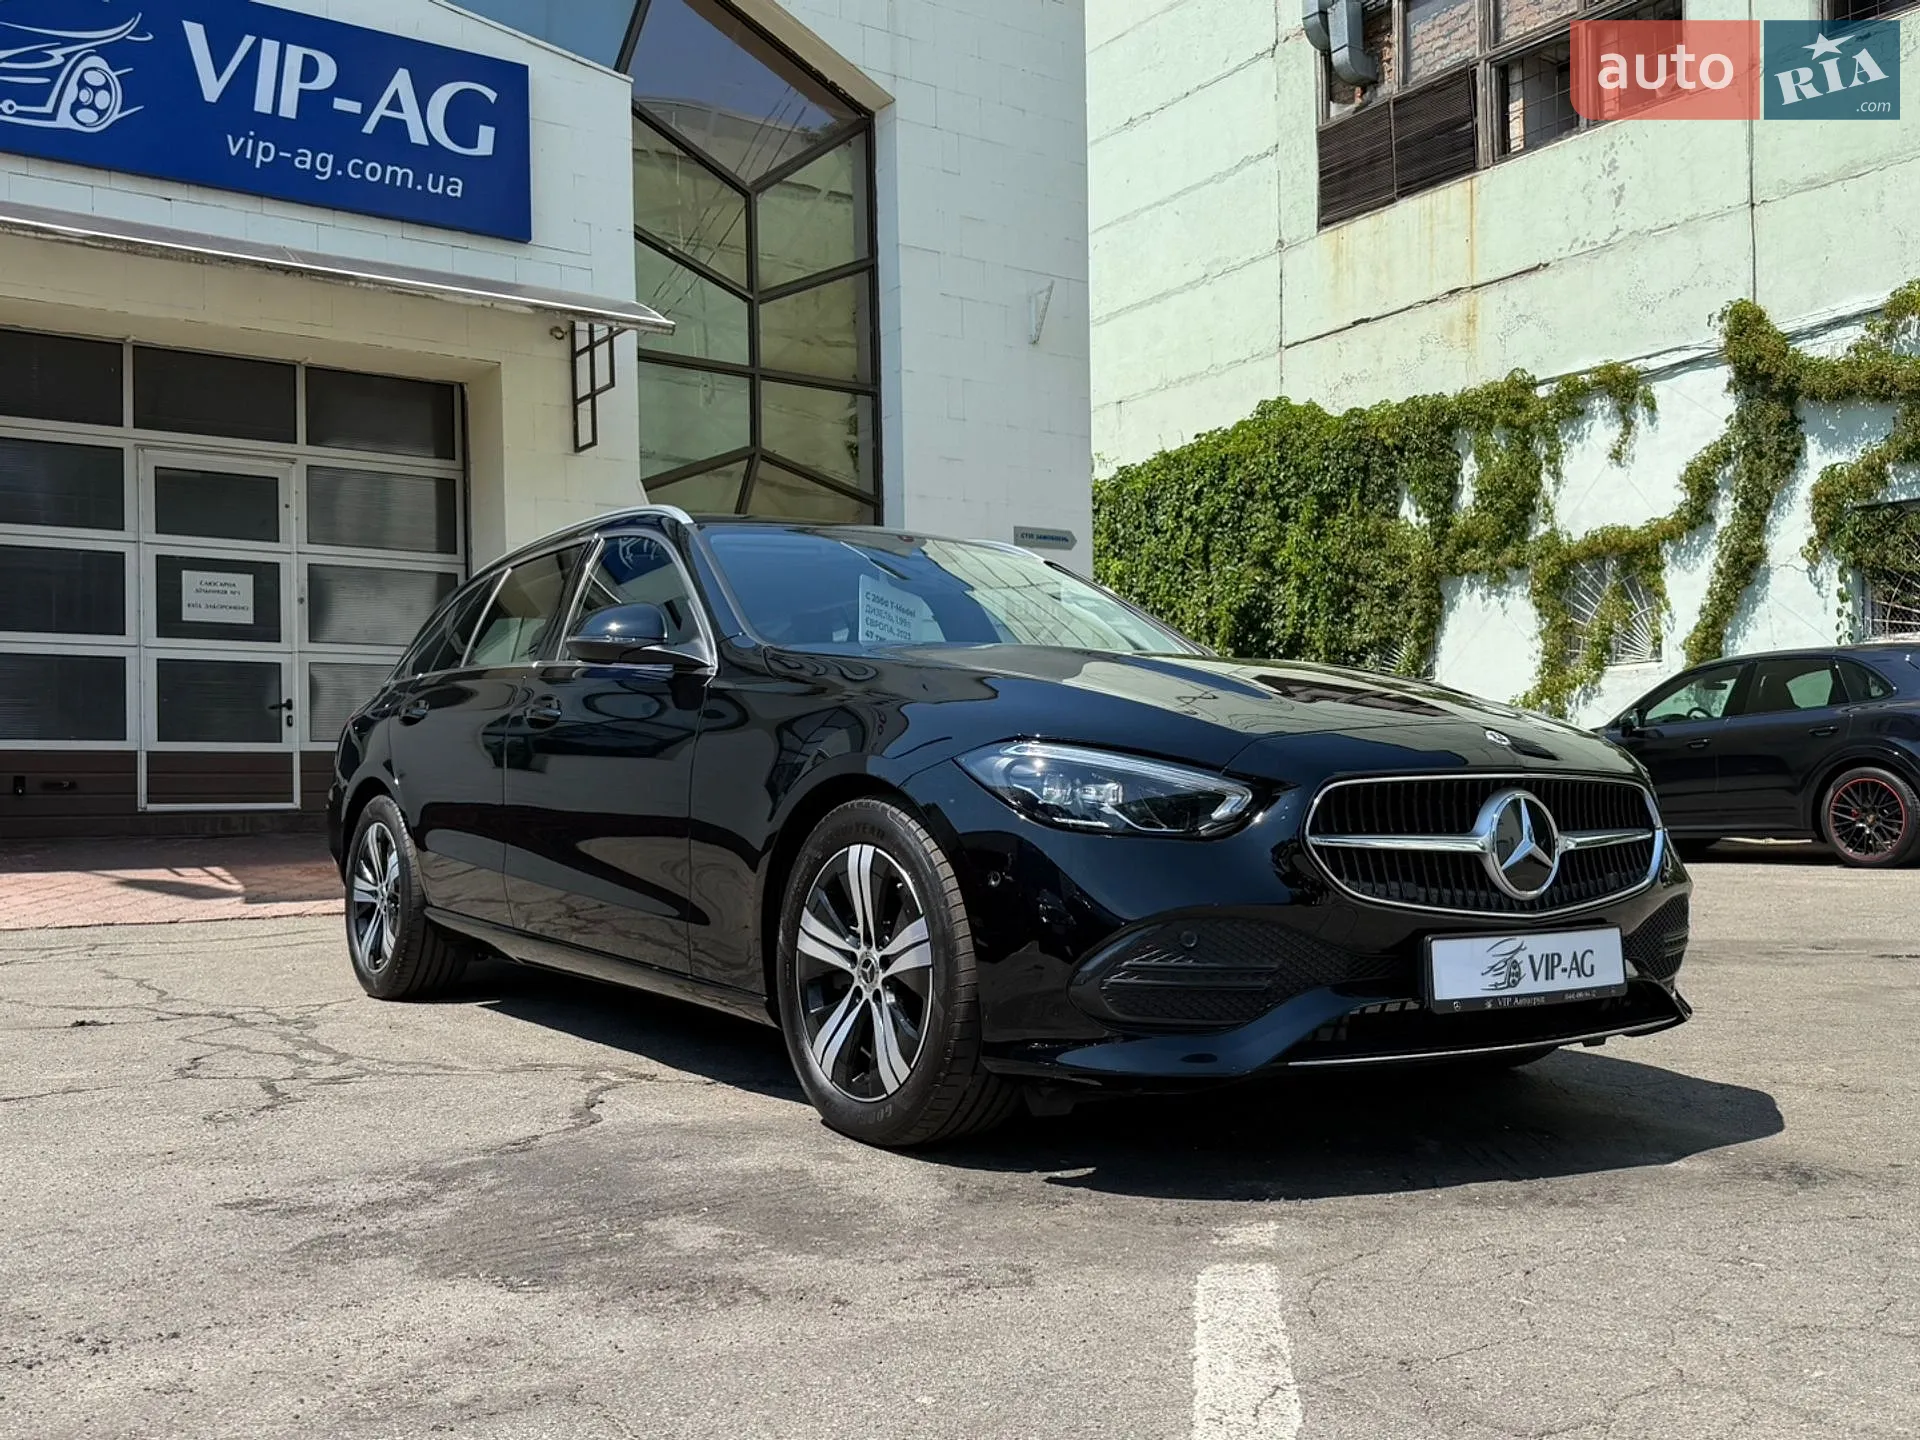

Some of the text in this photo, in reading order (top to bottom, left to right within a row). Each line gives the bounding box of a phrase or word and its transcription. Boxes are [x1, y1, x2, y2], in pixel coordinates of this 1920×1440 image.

[182, 20, 497, 156] VIP-AG
[226, 132, 463, 198] vip-ag.com.ua
[1528, 949, 1595, 981] VIP-AG
